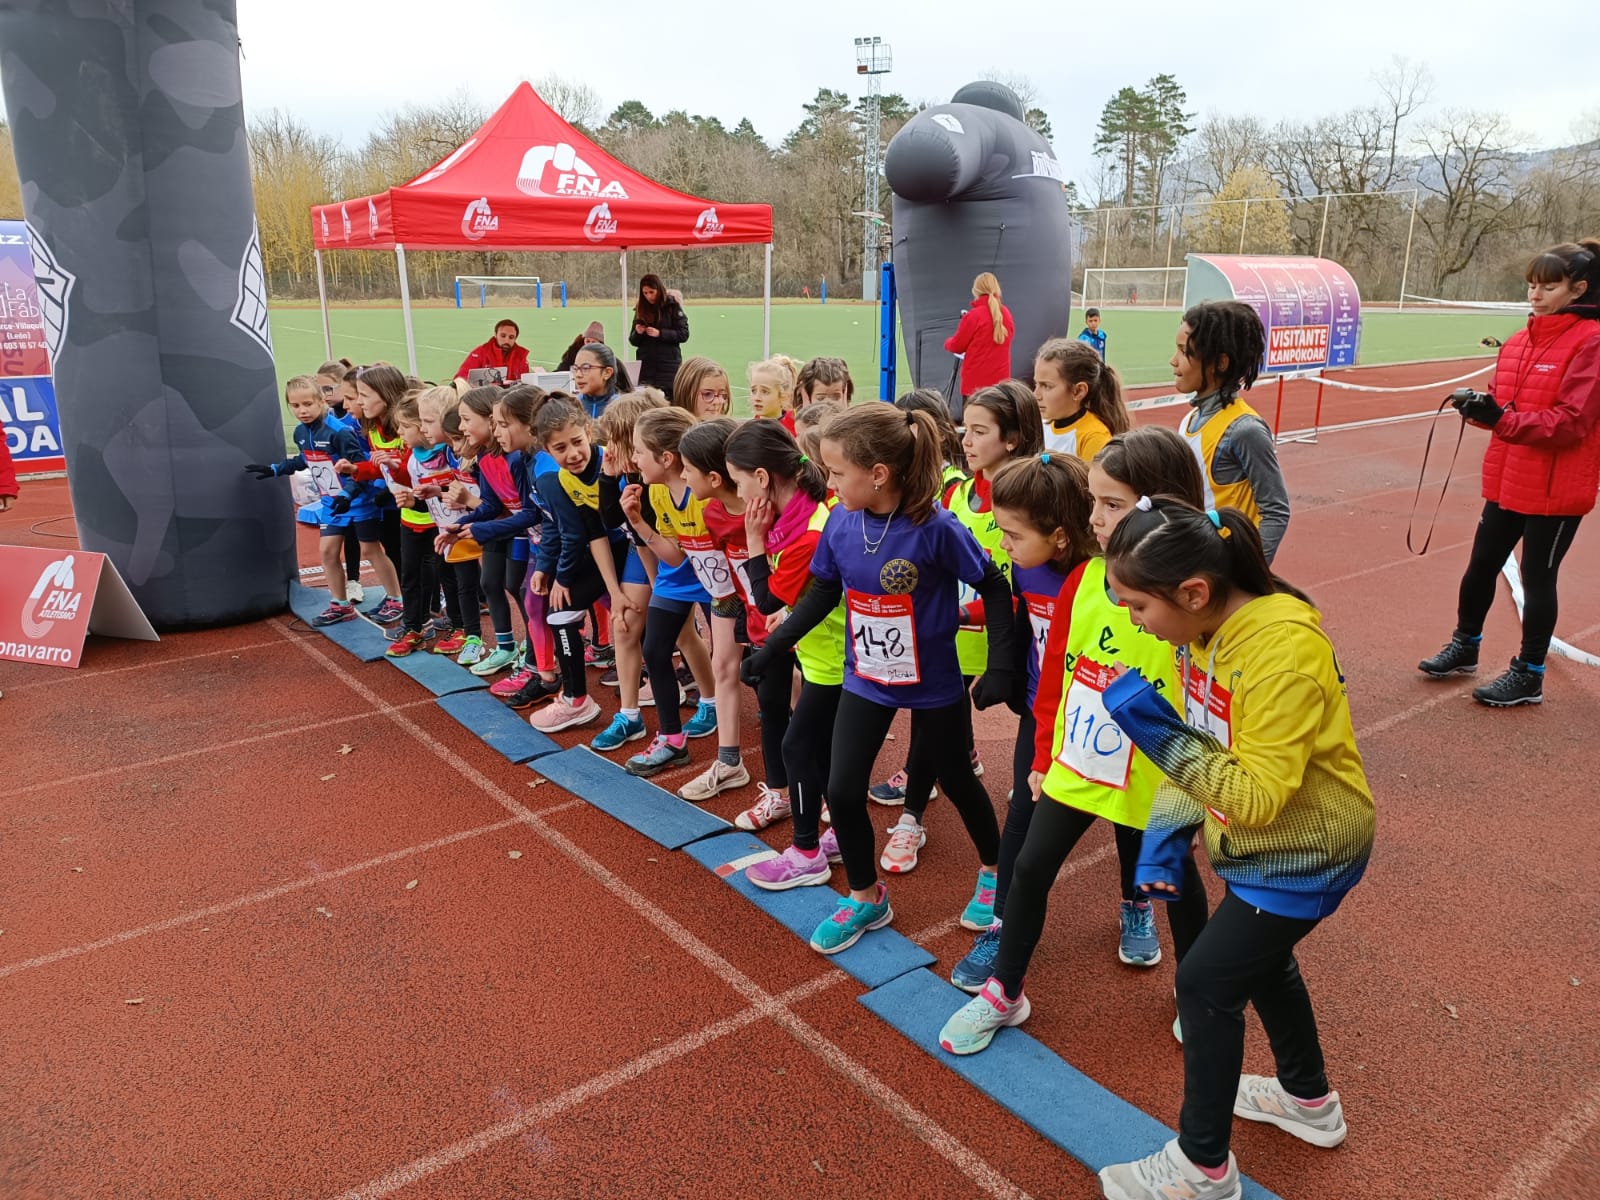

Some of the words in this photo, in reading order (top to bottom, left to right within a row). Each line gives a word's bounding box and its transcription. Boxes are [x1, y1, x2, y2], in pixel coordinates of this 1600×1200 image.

[556, 174, 629, 195] FNA
[475, 215, 499, 226] FNA
[596, 220, 617, 230] FNA
[1271, 329, 1327, 348] VISITANTE
[1269, 348, 1325, 364] KANPOKOAK
[43, 590, 82, 612] FNA
[37, 609, 76, 621] ATLETISMO
[855, 624, 905, 659] 148
[1066, 706, 1122, 757] 110
